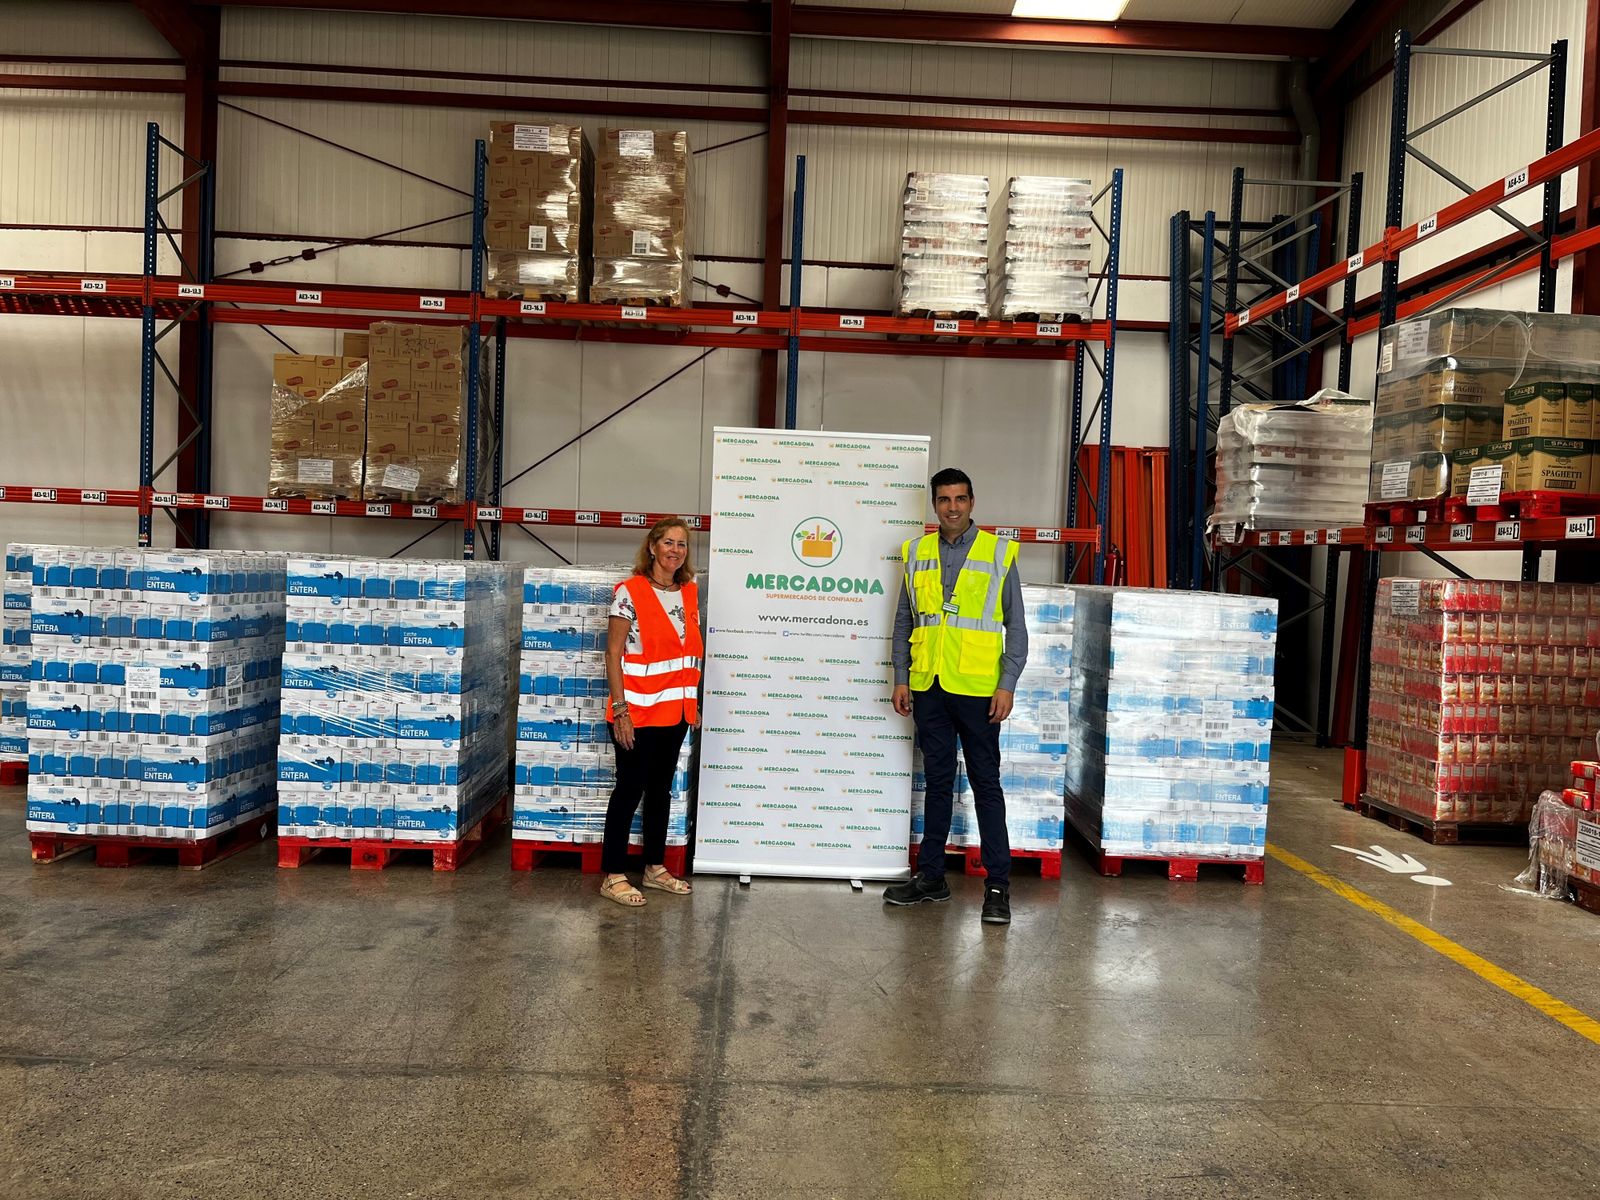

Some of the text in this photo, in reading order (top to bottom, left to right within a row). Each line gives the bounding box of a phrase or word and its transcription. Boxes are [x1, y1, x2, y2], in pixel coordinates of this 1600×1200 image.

[1507, 172, 1525, 190] AE4-5.3
[1508, 417, 1532, 426] SPAGHETTI
[1541, 469, 1582, 479] SPAGHETTI
[1497, 526, 1512, 536] AE4-5.2
[1569, 522, 1586, 534] AE4-6.1
[146, 581, 175, 590] ENTERA
[746, 573, 884, 595] MERCADONA
[766, 593, 817, 601] SUPERMERCADOS
[758, 614, 869, 627] www.mercadona.es
[1233, 708, 1246, 716] ERA
[29, 720, 56, 728] ENTERA
[144, 772, 173, 780] ENTERA
[29, 812, 55, 820] ENTERA
